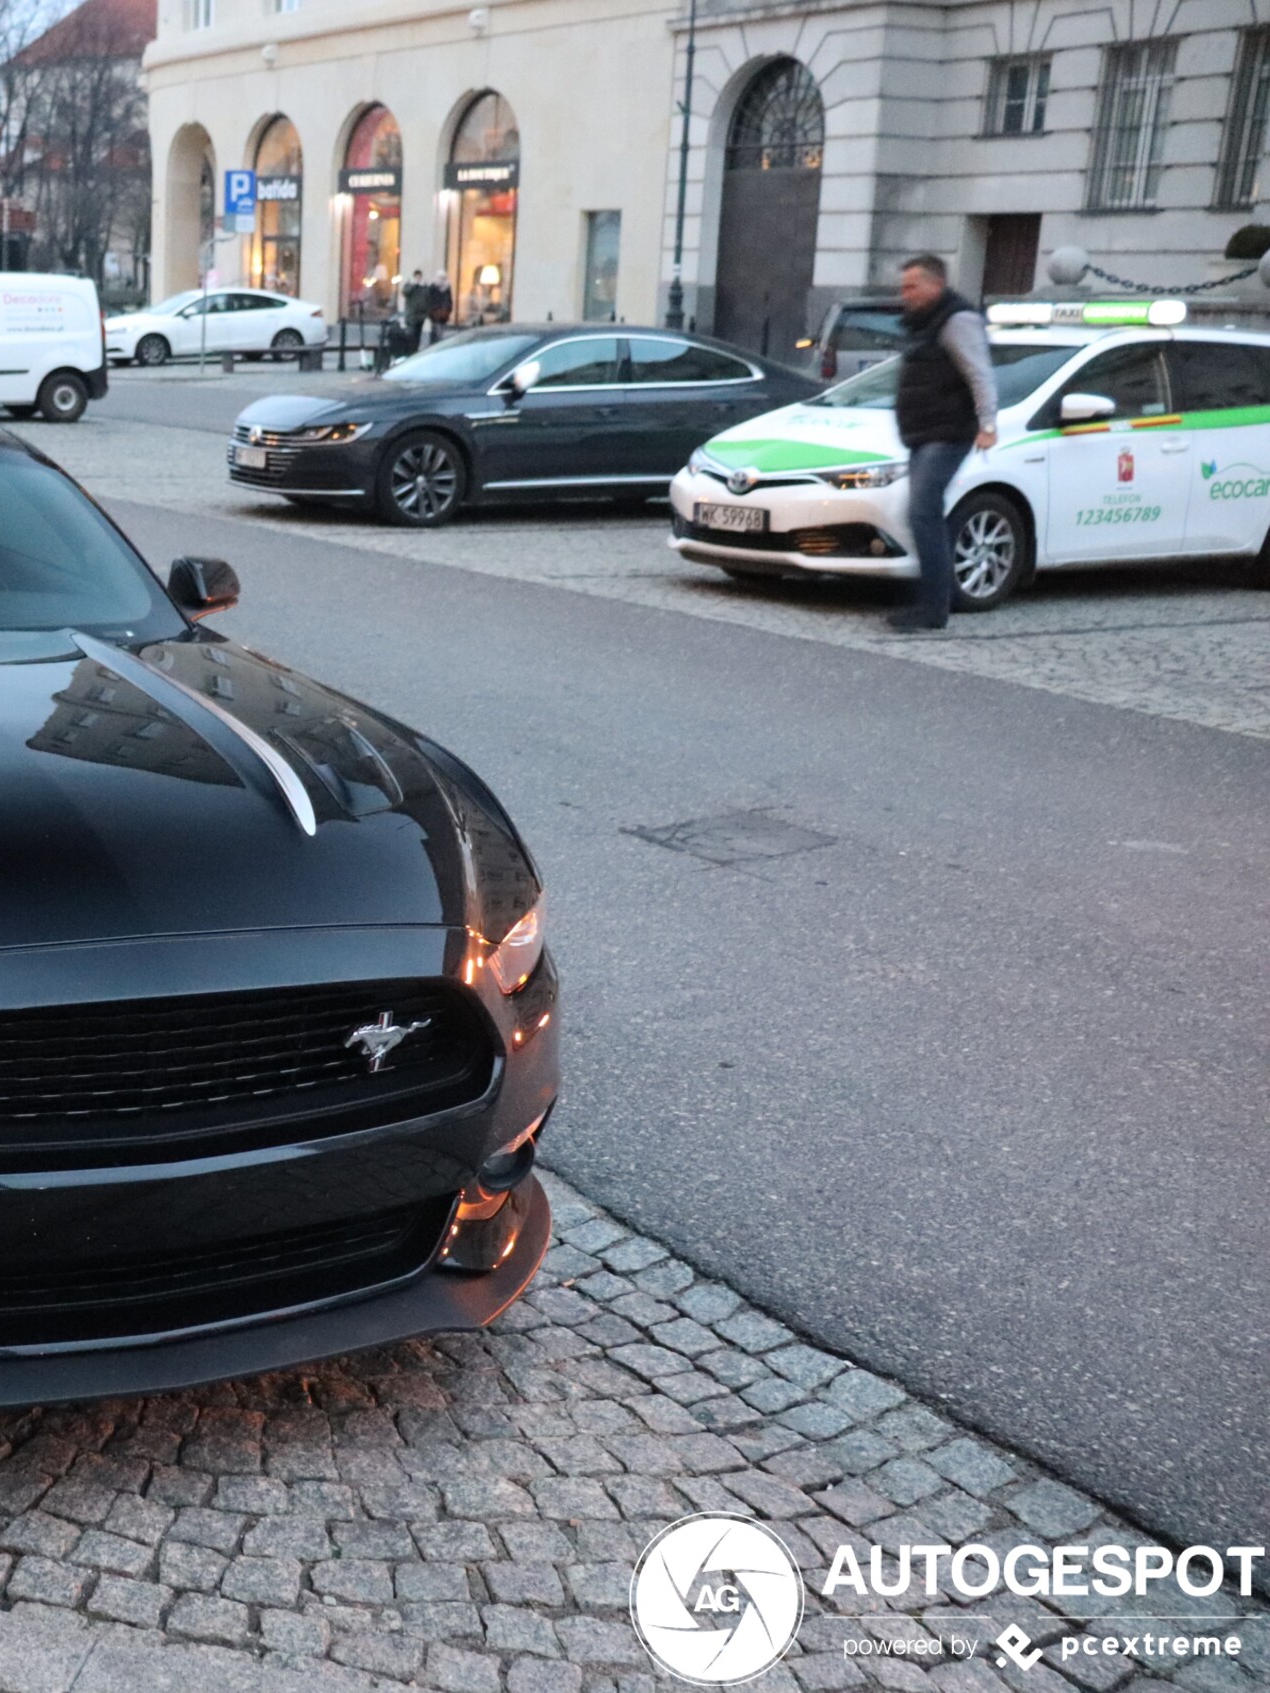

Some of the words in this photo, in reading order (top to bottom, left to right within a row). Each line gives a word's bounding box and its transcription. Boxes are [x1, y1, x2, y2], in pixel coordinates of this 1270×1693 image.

[231, 173, 251, 203] P
[1055, 308, 1080, 318] TAXI
[1102, 494, 1142, 504] TELEFON
[1209, 477, 1270, 500] ecocar
[701, 504, 718, 523] WK
[722, 507, 762, 528] 59968
[1076, 506, 1161, 526] 123456789
